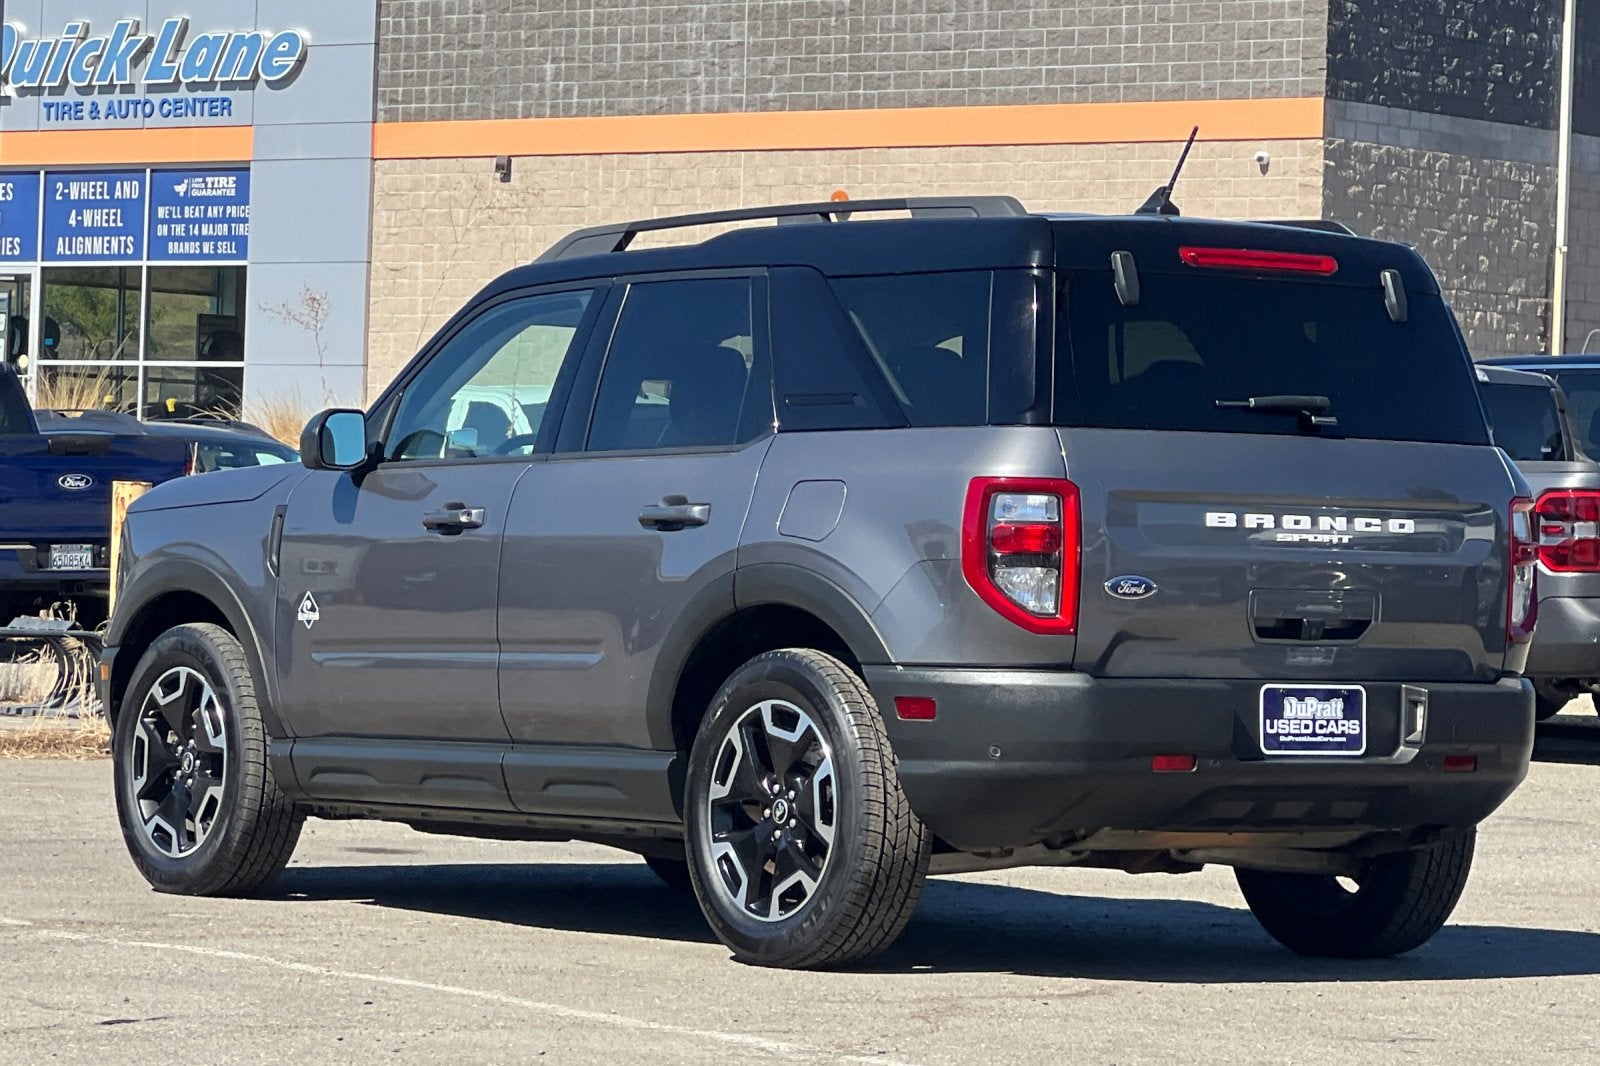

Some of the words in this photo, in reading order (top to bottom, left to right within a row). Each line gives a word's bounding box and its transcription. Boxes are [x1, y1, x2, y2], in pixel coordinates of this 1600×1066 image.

[142, 17, 303, 84] Lane
[43, 101, 83, 121] TIRE
[89, 101, 101, 120] &
[104, 98, 154, 120] AUTO
[158, 97, 232, 118] CENTER
[55, 181, 110, 200] 2-WHEEL
[114, 180, 139, 200] AND
[205, 176, 237, 189] TIRE
[191, 188, 236, 197] GUARANTEE
[68, 208, 124, 228] 4-WHEEL
[157, 206, 182, 219] WE'LL
[184, 205, 205, 219] BEAT
[207, 205, 224, 218] ANY
[226, 205, 250, 218] PRICE
[157, 224, 168, 237] ON
[171, 224, 186, 236] THE
[189, 224, 199, 236] 14
[201, 223, 229, 236] MAJOR
[231, 223, 249, 236] TIRE
[0, 236, 21, 256] IES
[56, 235, 134, 256] ALIGNMENTS
[168, 241, 200, 254] BRANDS
[202, 241, 215, 254] WE
[217, 240, 237, 254] SELL
[1205, 511, 1415, 534] BRONCO
[1276, 532, 1354, 544] SPORT
[1117, 580, 1146, 594] Ford
[1283, 696, 1344, 720] DuPratt
[1265, 719, 1313, 734] USED
[1315, 719, 1361, 735] CARS
